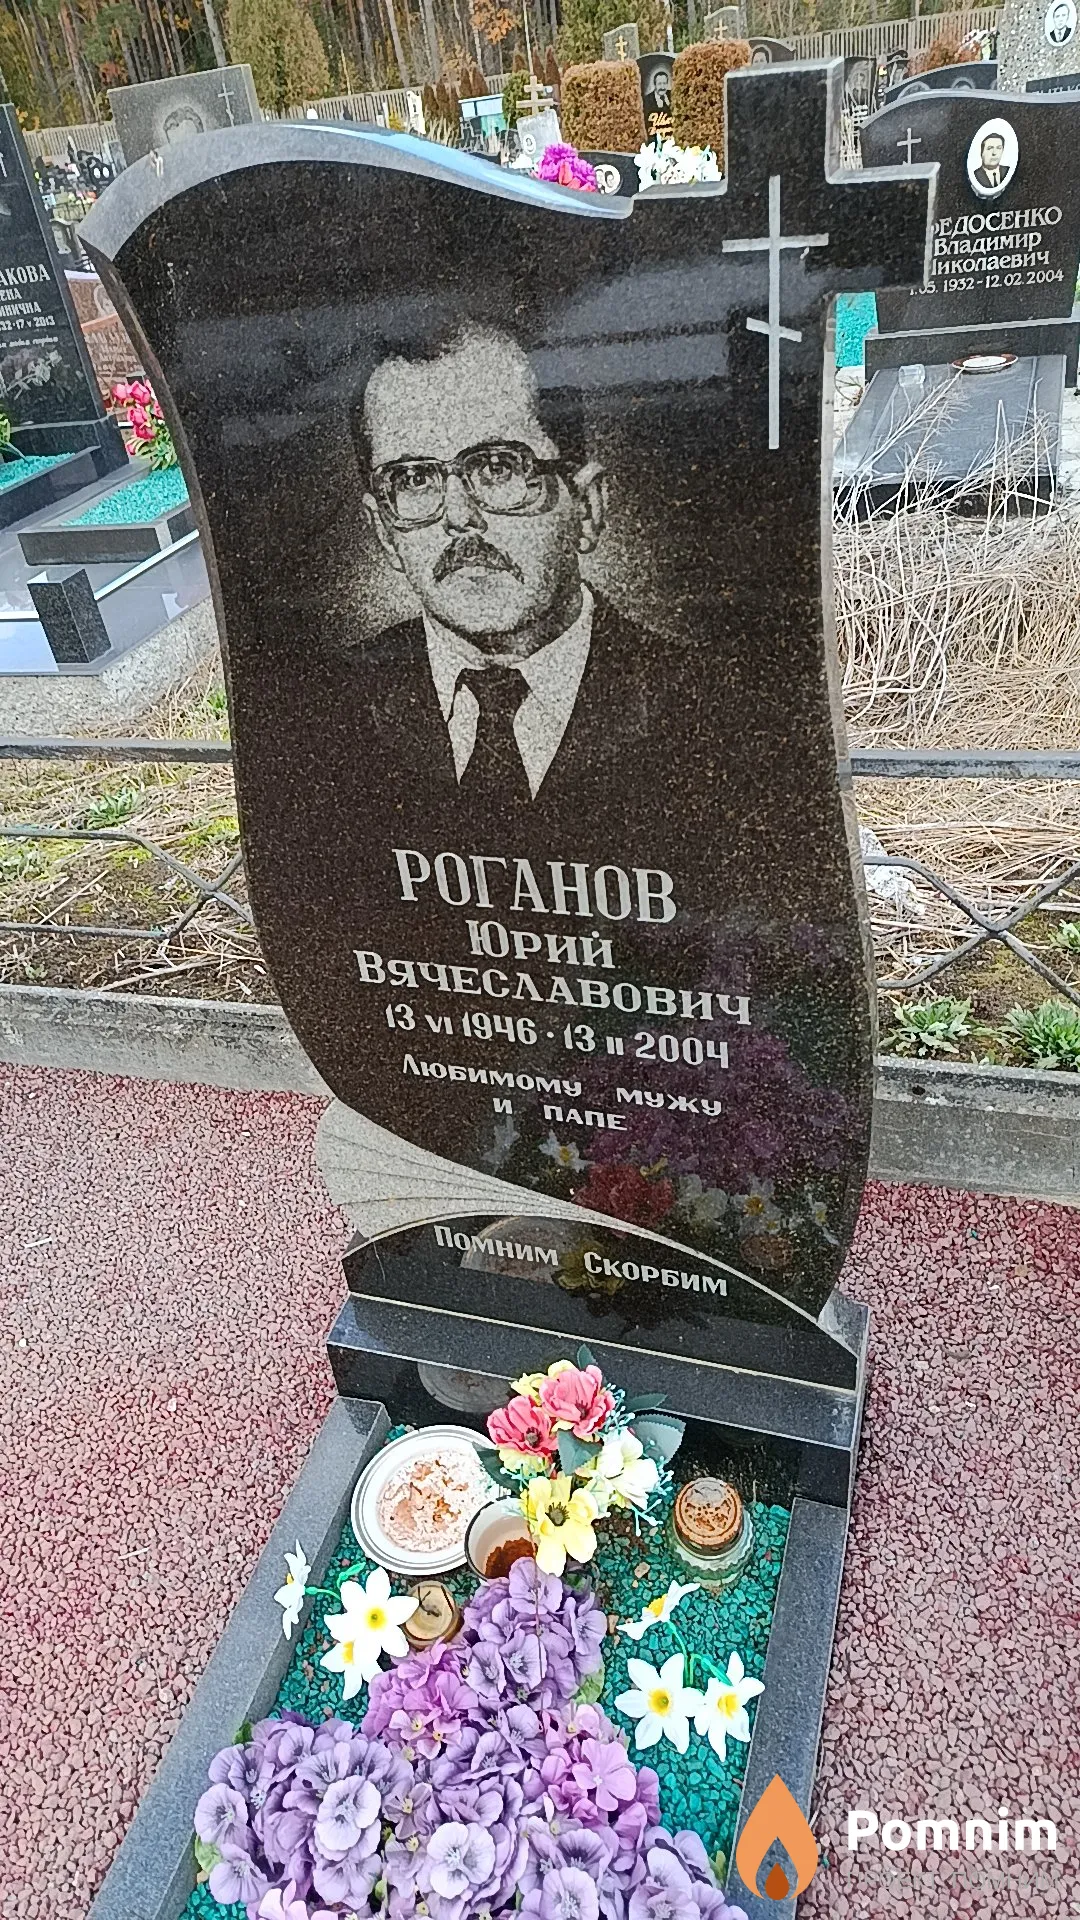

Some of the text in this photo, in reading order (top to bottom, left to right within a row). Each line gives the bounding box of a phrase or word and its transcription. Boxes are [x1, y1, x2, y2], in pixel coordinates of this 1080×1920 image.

[933, 232, 1042, 256] Владимир
[391, 848, 678, 923] РОГАНОВ
[385, 1003, 416, 1031] 13
[461, 1011, 537, 1045] 1946
[563, 1023, 596, 1053] 13
[634, 1031, 730, 1069] 2004
